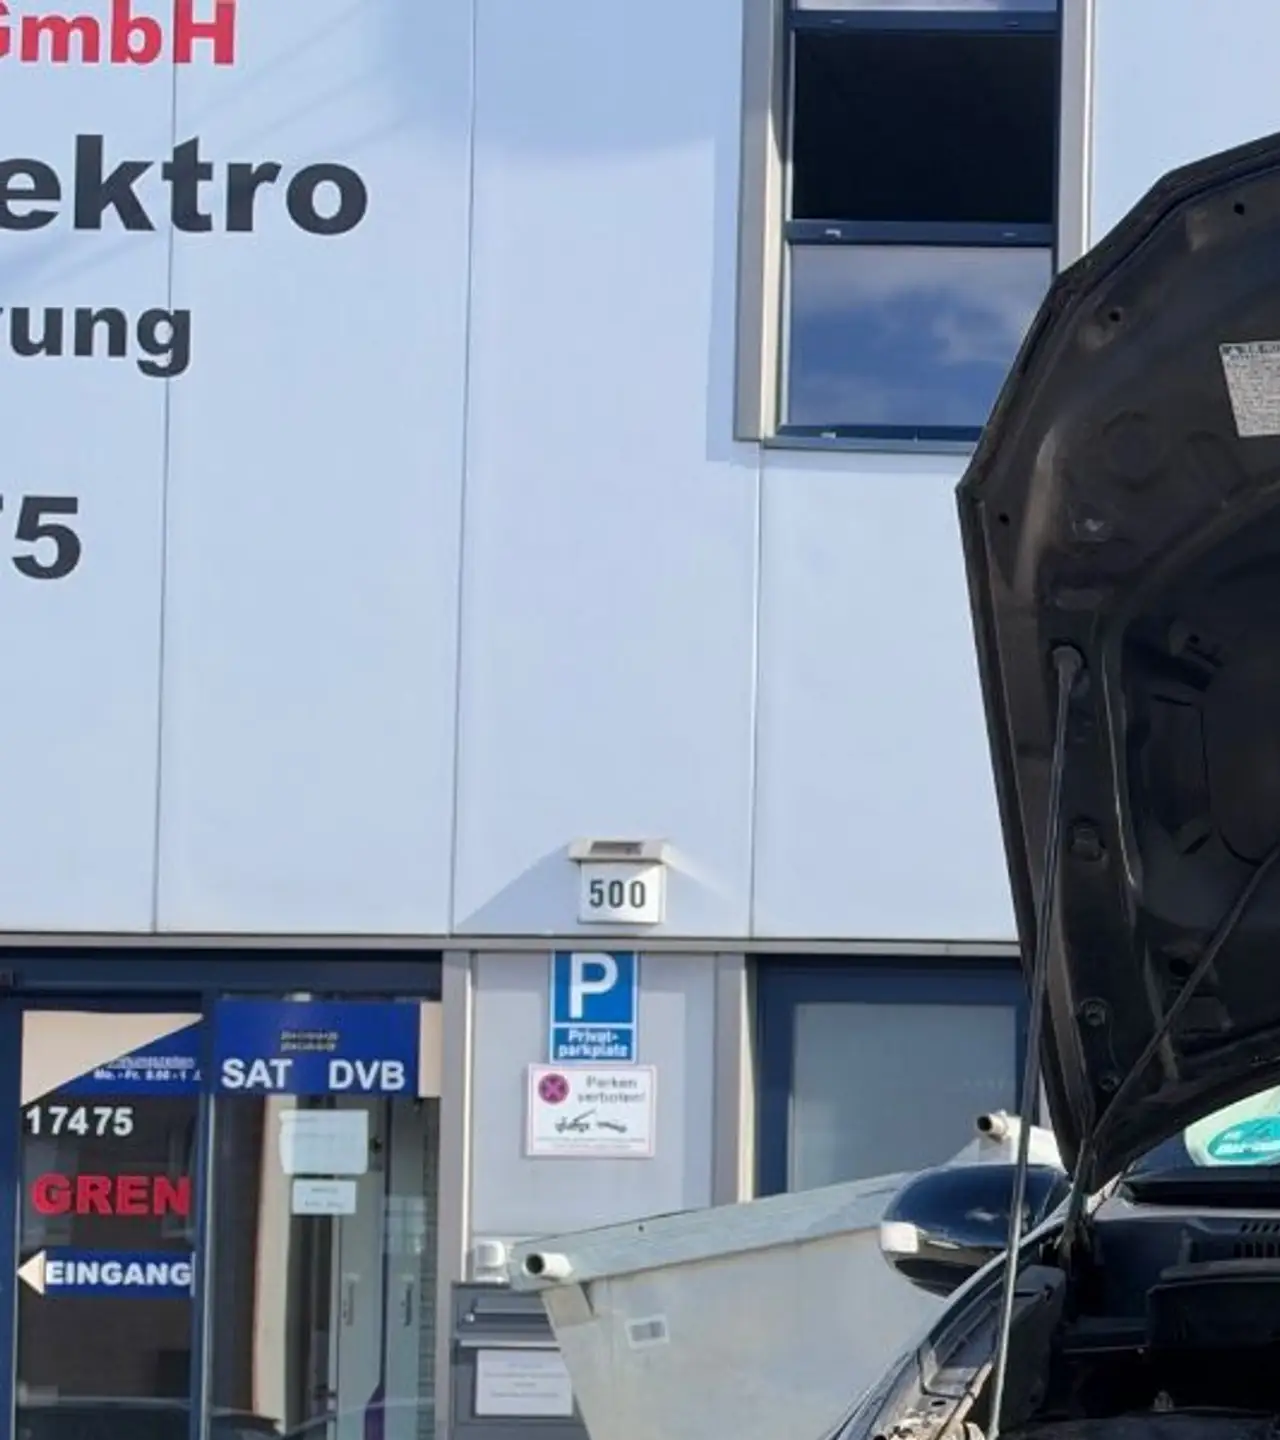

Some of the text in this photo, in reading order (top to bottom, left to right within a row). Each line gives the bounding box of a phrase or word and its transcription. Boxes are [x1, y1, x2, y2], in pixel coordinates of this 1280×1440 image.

[0, 0, 235, 64] mbH
[0, 306, 192, 378] ung
[589, 879, 646, 909] 500
[569, 952, 619, 1018] P
[221, 1058, 293, 1088] SAT
[328, 1059, 405, 1090] DVB
[31, 1173, 192, 1216] GREN
[45, 1261, 191, 1286] EINGANG
